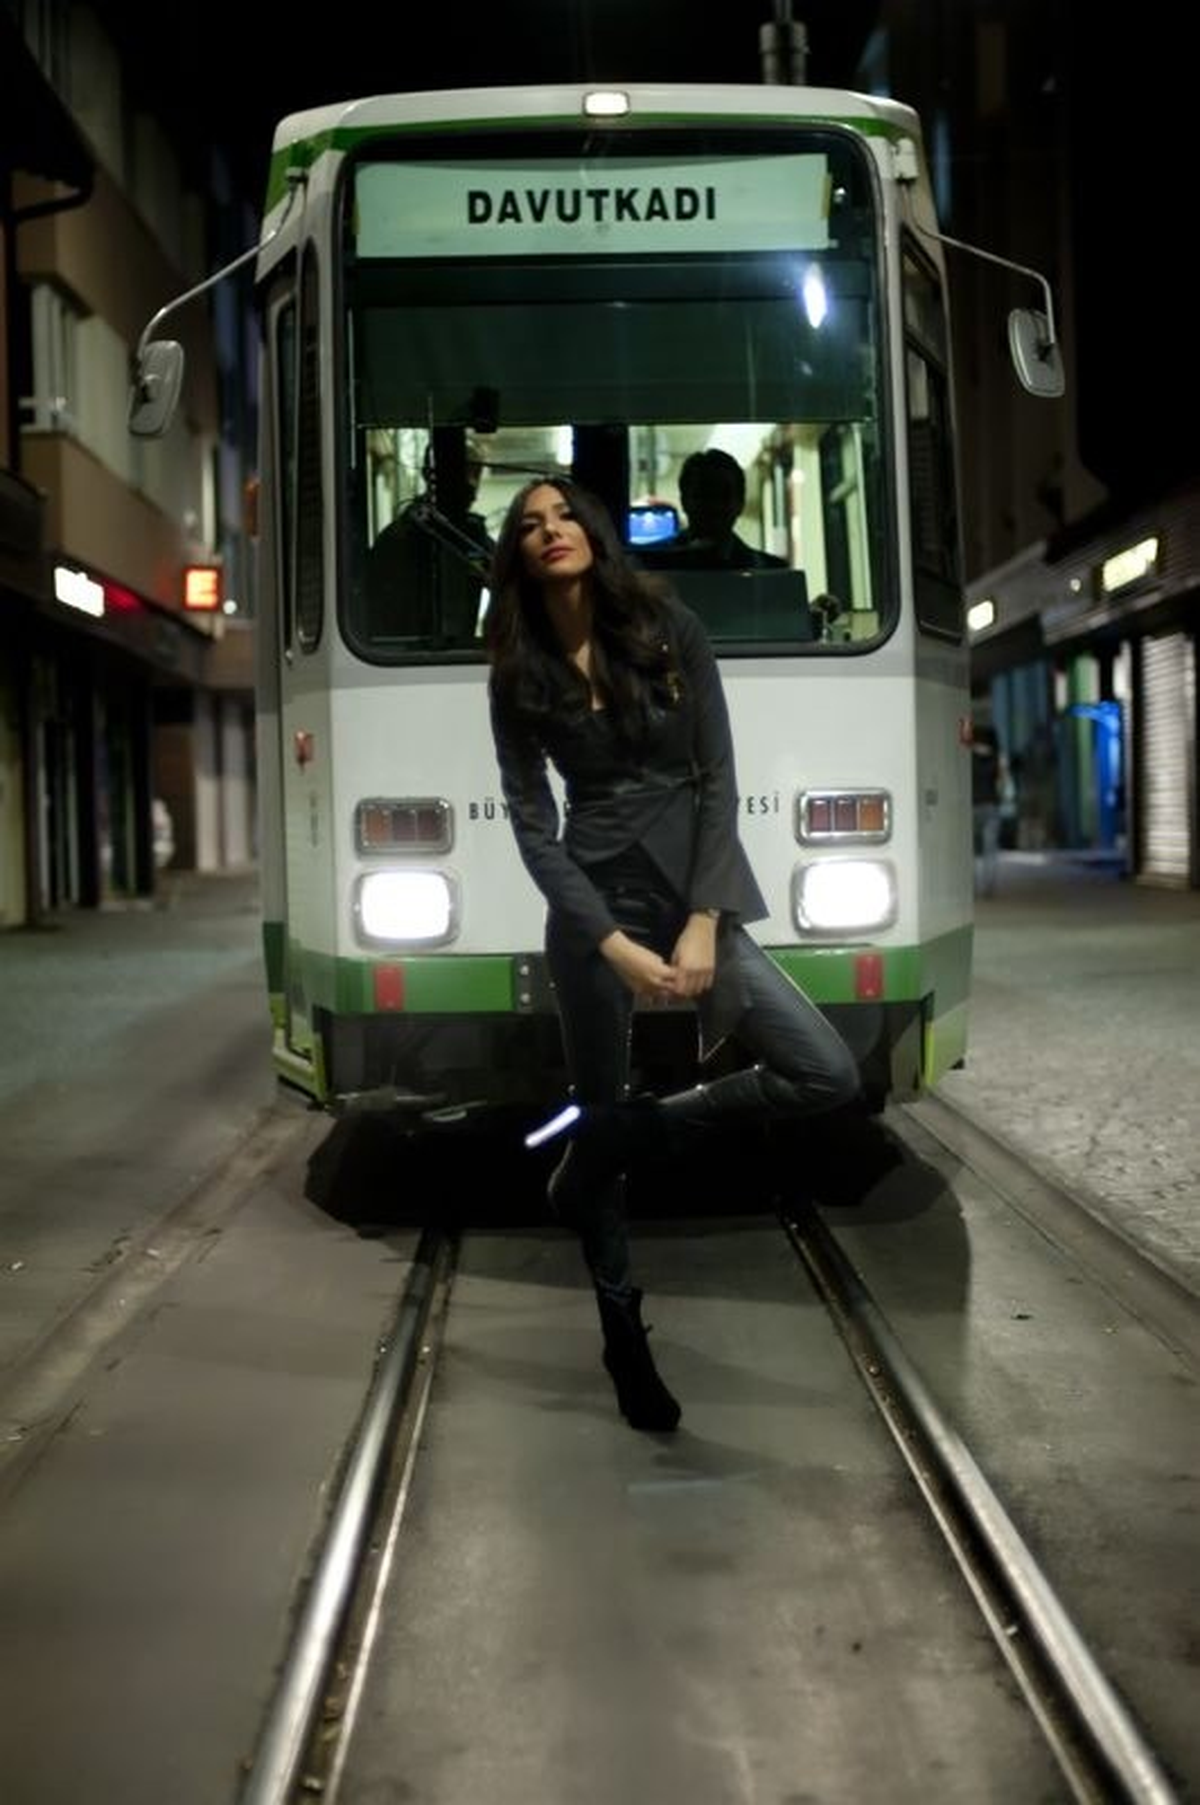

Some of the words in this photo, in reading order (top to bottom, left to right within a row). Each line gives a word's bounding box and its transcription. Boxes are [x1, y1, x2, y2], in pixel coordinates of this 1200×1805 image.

[467, 187, 716, 224] DAVUTKADI
[469, 797, 509, 820] BÜY
[738, 791, 779, 814] ESİ
